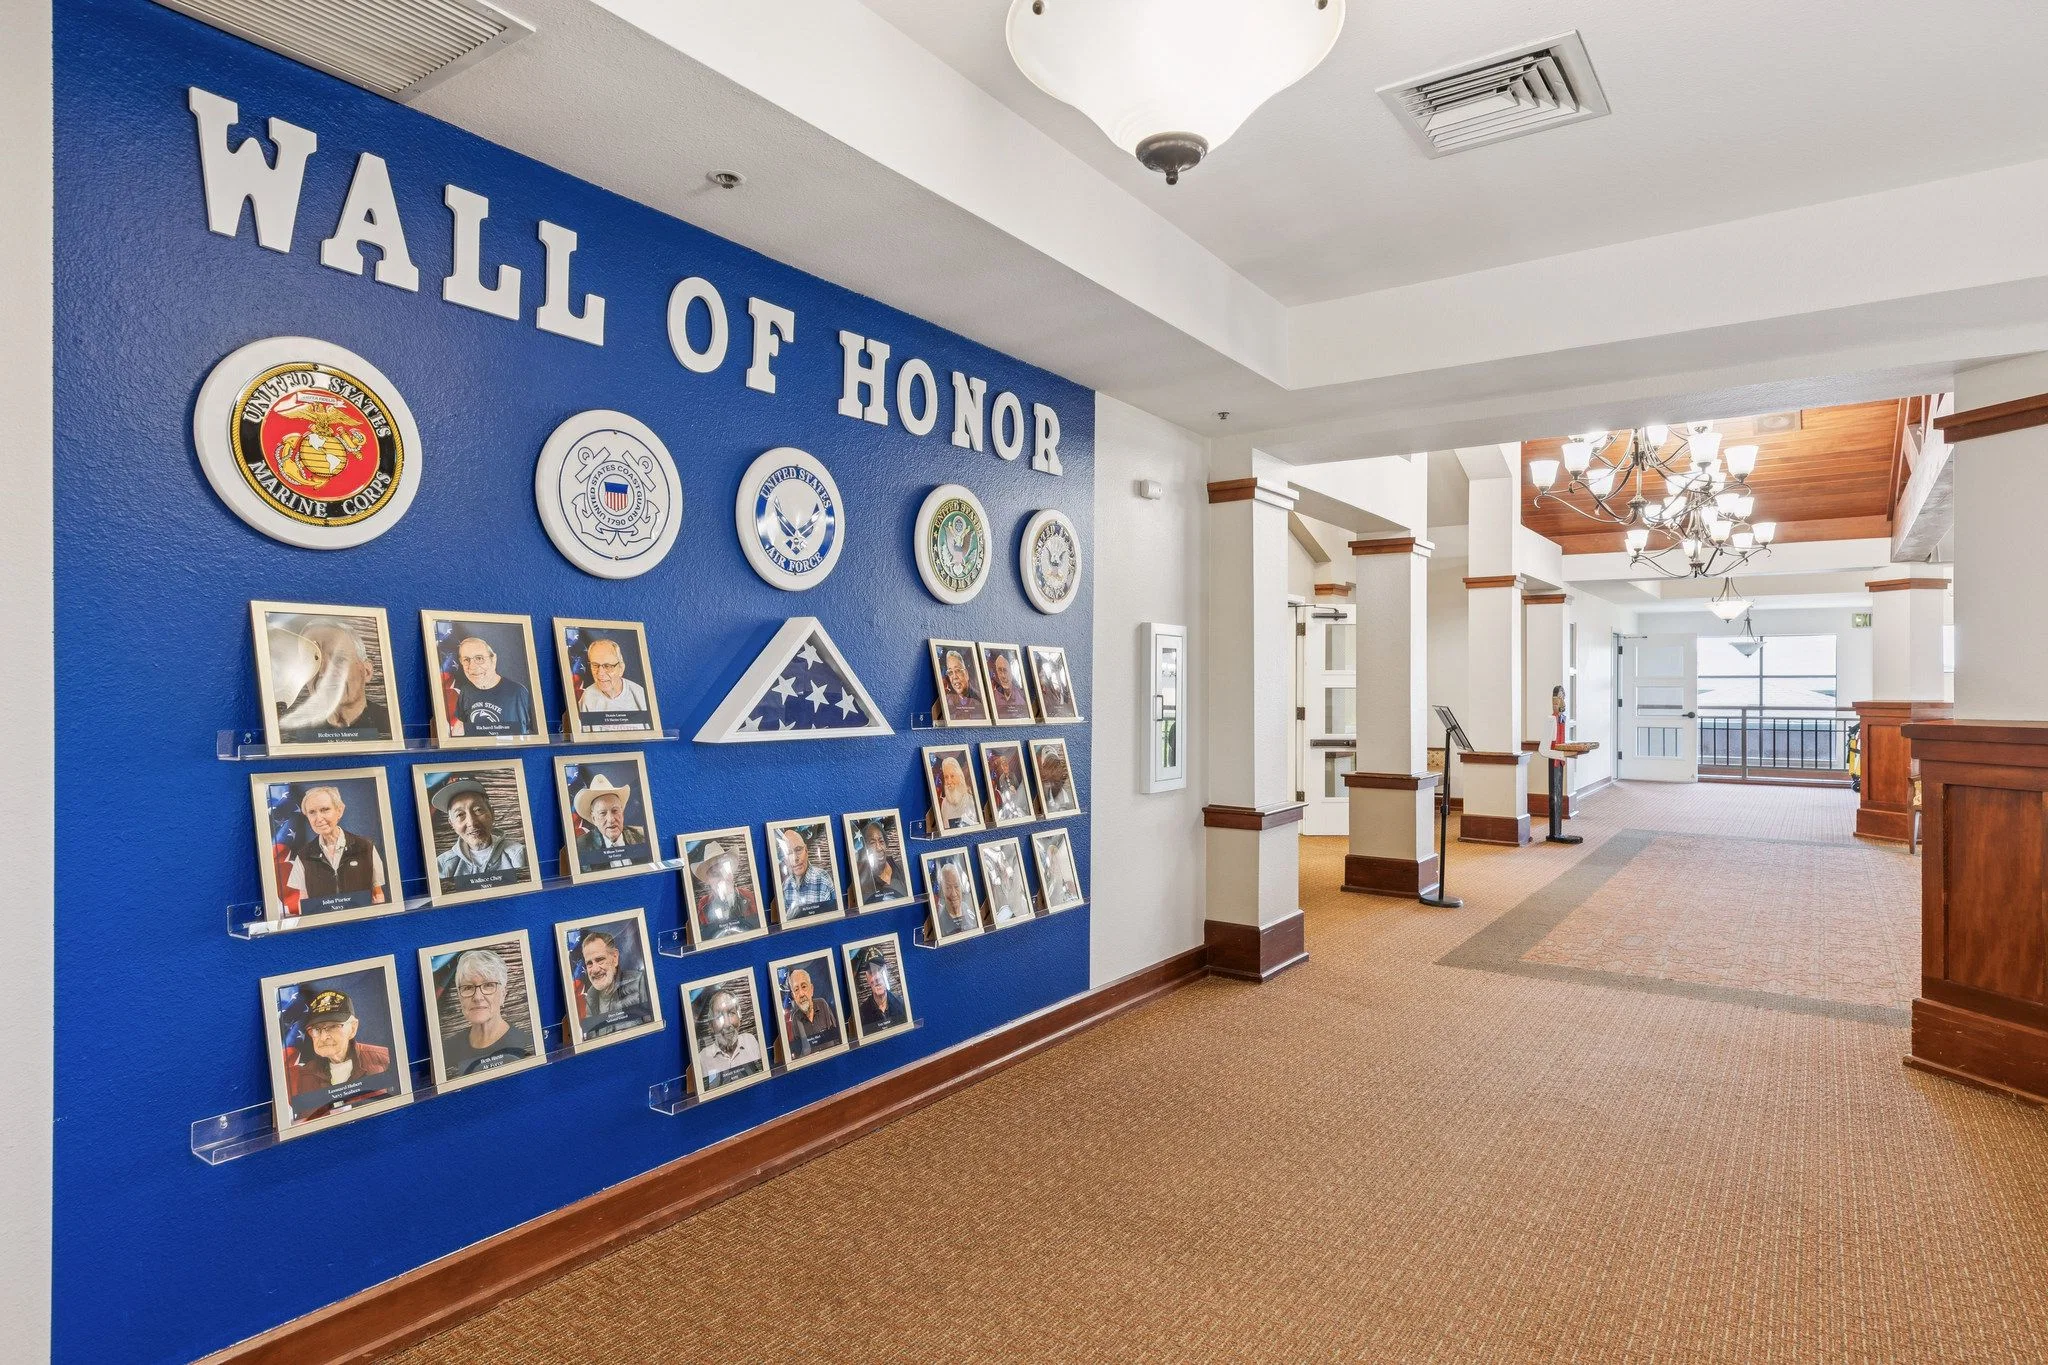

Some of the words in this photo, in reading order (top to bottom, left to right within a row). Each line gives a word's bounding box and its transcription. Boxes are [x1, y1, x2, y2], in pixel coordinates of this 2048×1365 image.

[189, 86, 605, 346] WALL
[667, 276, 795, 394] OF
[837, 329, 1063, 476] HONOR
[243, 371, 315, 423] UNITED
[329, 377, 391, 437] STATES
[249, 460, 327, 517] MARINE
[342, 472, 391, 514] CORPS
[592, 464, 616, 485] STATES
[618, 466, 640, 489] COAST
[760, 467, 796, 498] UNITED
[799, 469, 831, 508] STATES
[590, 487, 606, 520] UNITED
[628, 490, 642, 522] GUARD
[935, 501, 959, 527] UNITED
[607, 518, 626, 526] 1790
[767, 545, 786, 568] AIR
[788, 552, 823, 573] FORCE
[1855, 613, 1872, 627] EXI
[484, 701, 503, 715] STATE
